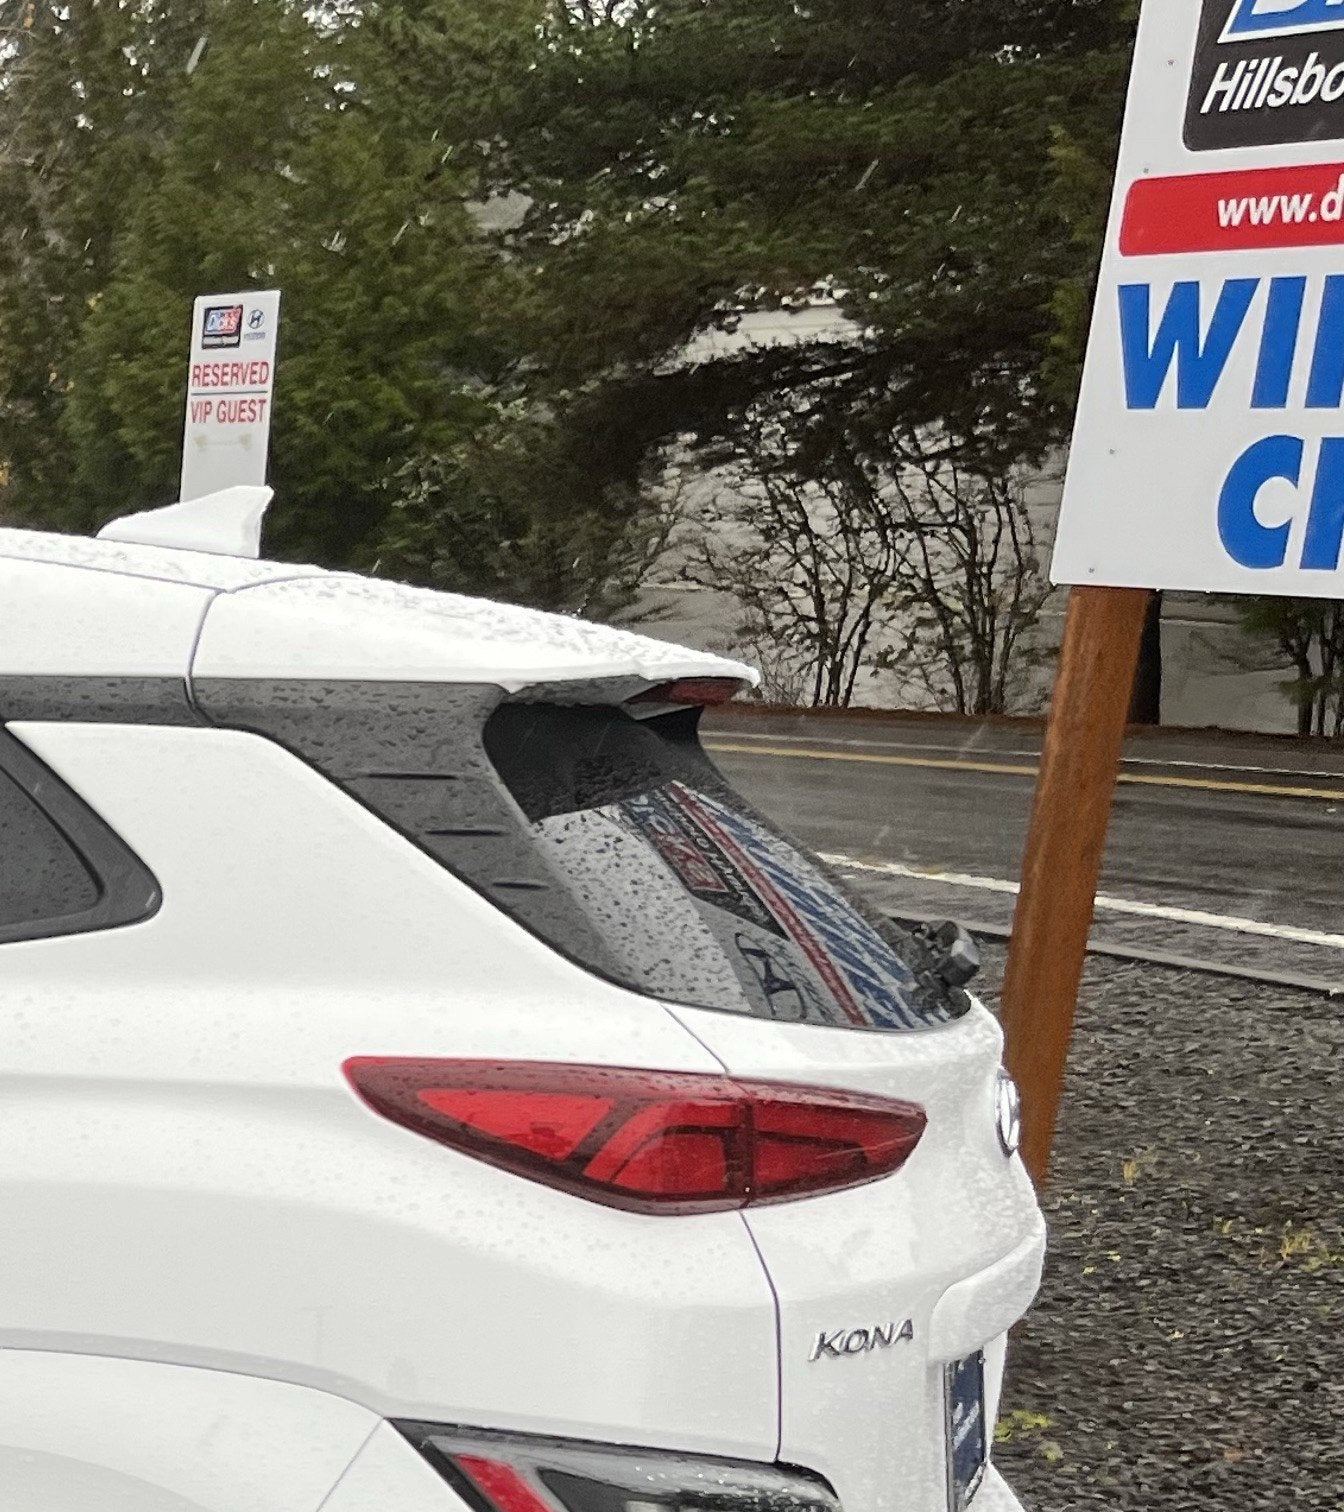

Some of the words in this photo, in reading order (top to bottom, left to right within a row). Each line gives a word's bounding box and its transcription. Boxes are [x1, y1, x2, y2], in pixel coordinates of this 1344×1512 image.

[1199, 51, 1344, 114] Hillsbo
[1217, 173, 1344, 228] www.d
[192, 361, 270, 387] RESERVED
[190, 400, 212, 424] VIP
[216, 399, 267, 423] GUEST
[808, 1318, 914, 1362] KONA
